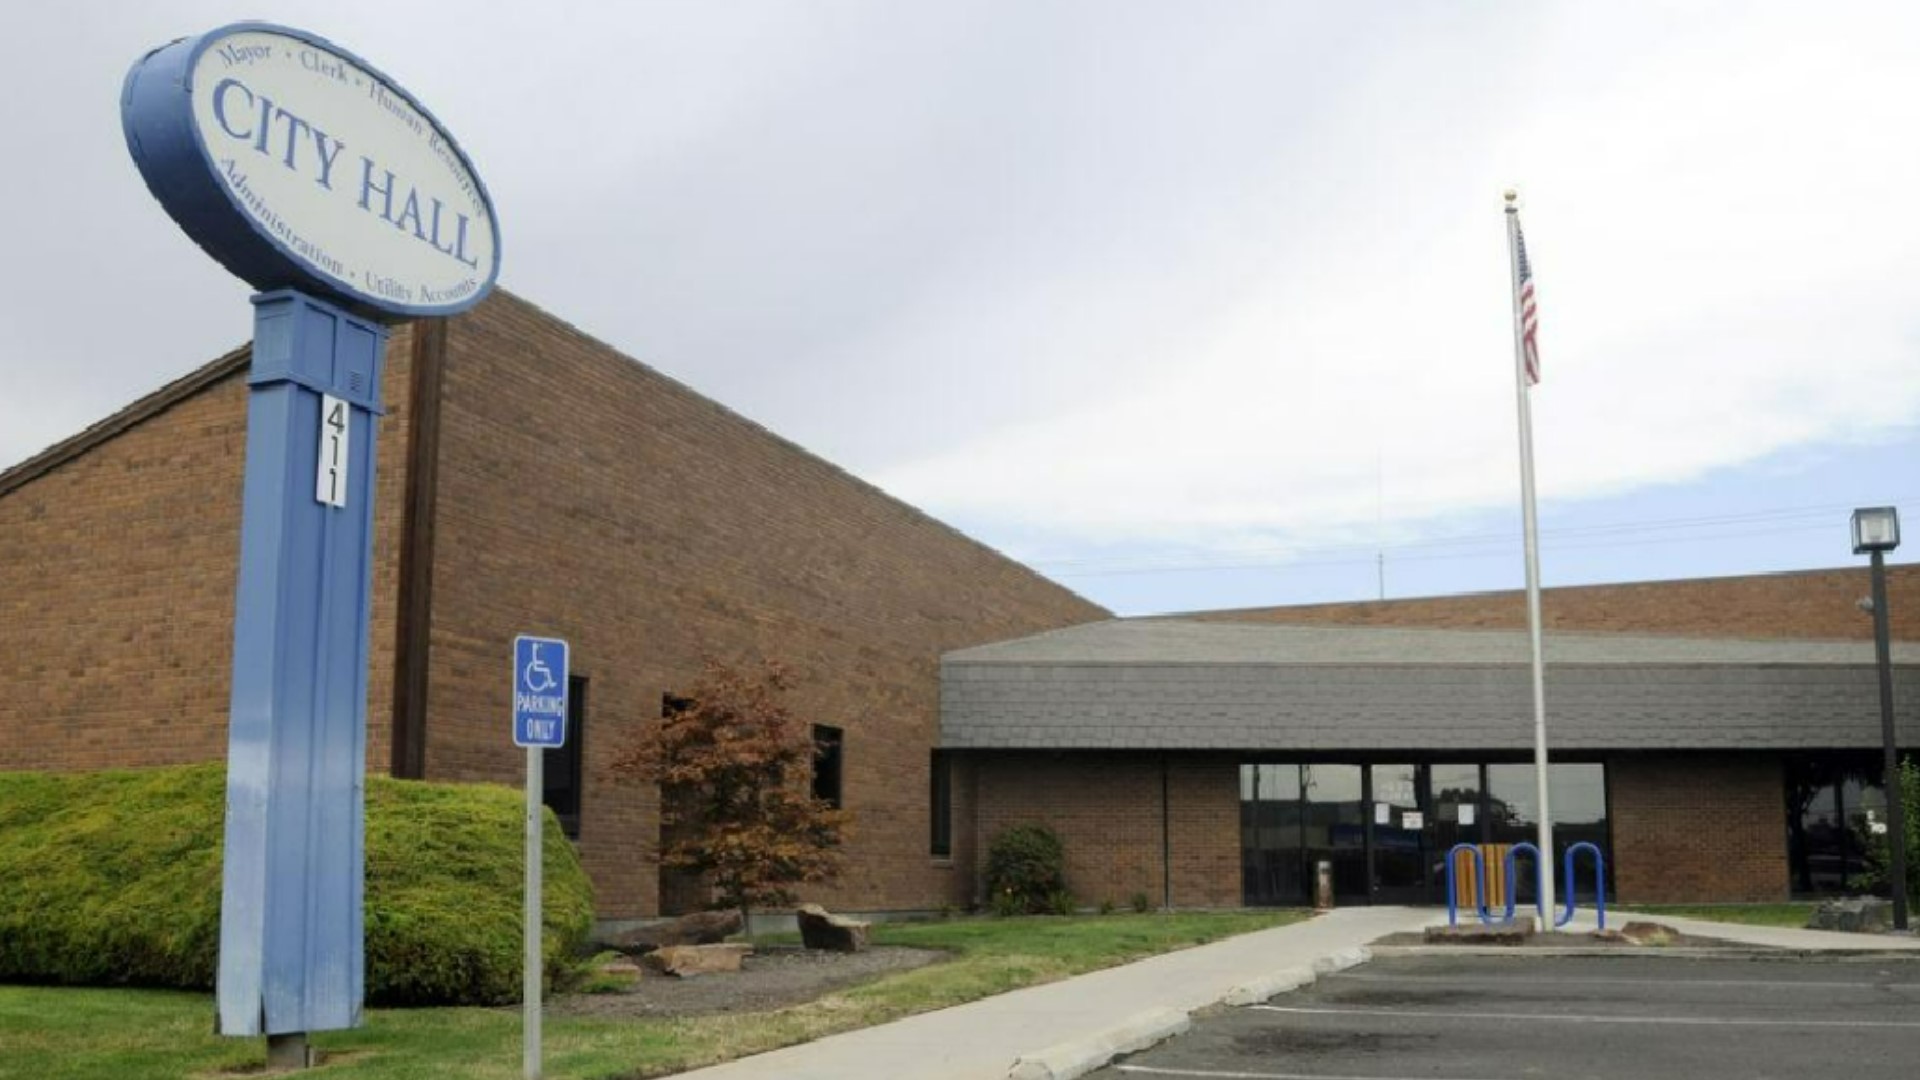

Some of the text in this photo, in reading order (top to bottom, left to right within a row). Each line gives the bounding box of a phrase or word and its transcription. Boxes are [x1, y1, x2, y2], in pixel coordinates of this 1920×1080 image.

[216, 43, 272, 69] Mayor
[300, 50, 348, 84] Clerk
[369, 79, 423, 135] Human
[212, 78, 478, 270] CITY HALL
[220, 158, 477, 304] Administration Utility Accounts
[517, 692, 563, 717] PARKING
[527, 718, 556, 740] ONLY
